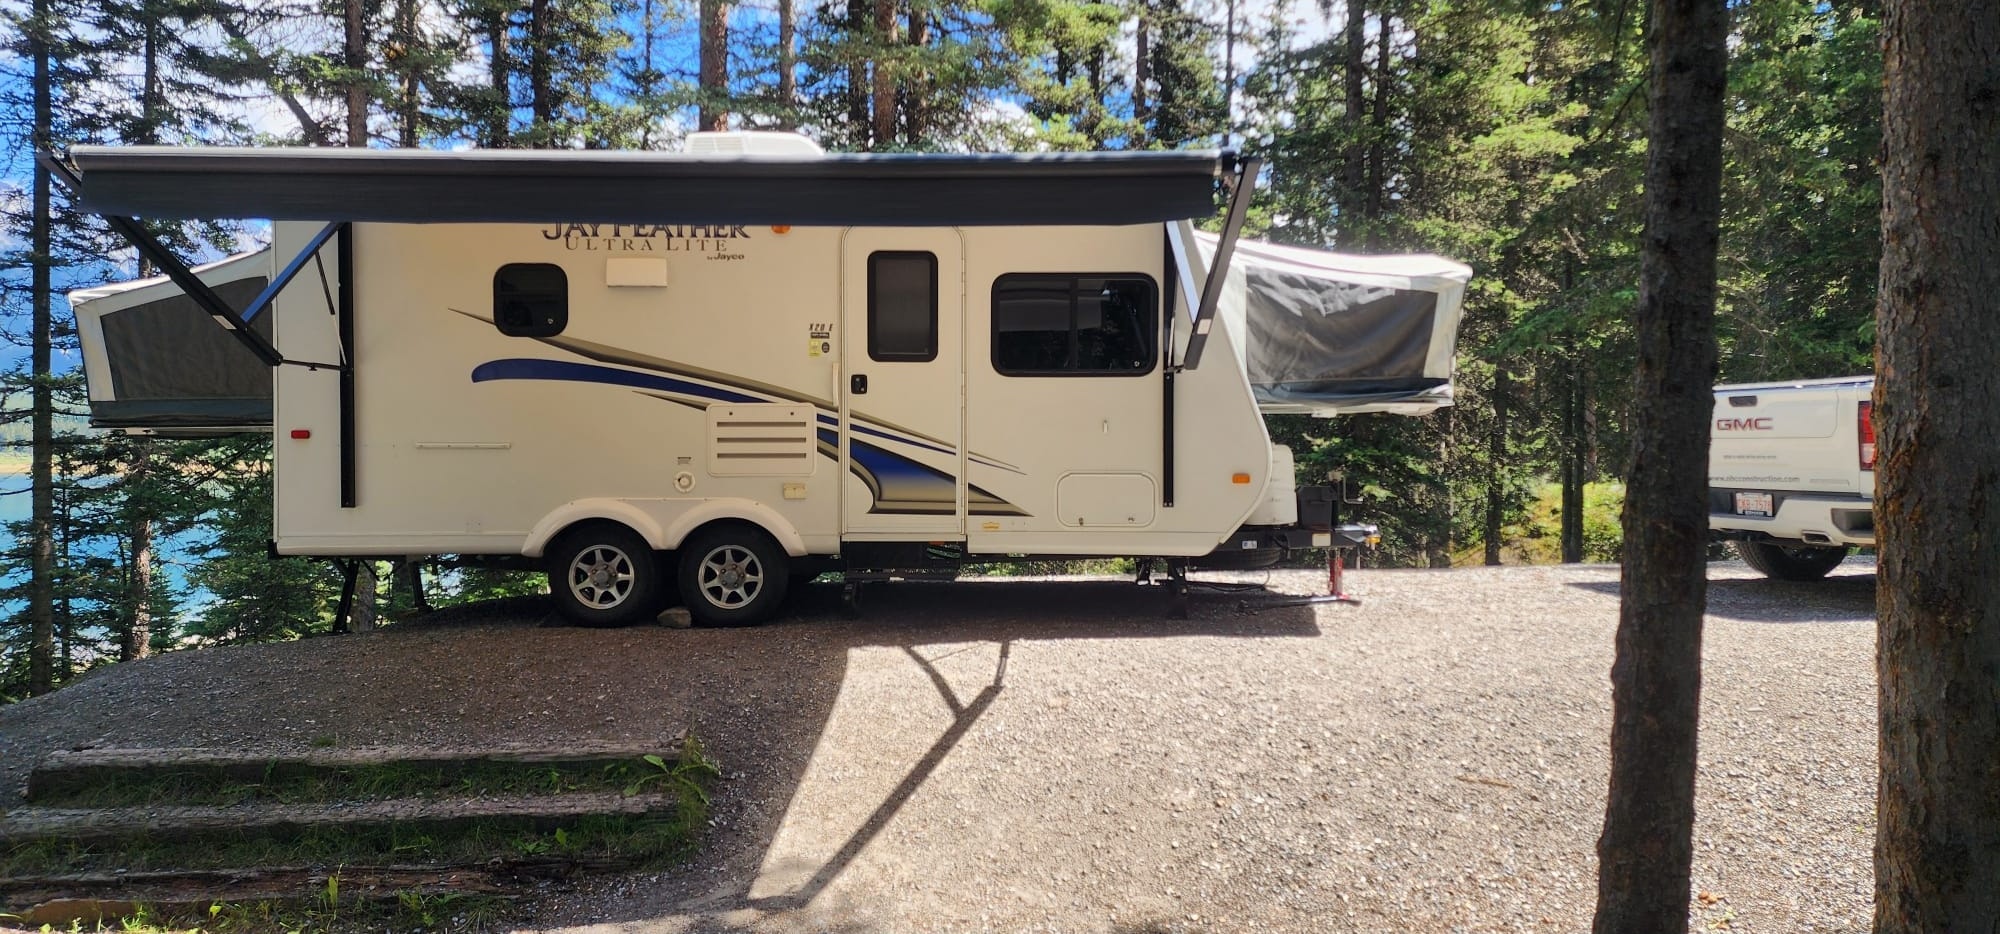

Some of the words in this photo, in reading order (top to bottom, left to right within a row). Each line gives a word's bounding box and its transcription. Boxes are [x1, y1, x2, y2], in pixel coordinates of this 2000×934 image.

[565, 237, 654, 251] ULTRA
[666, 237, 727, 251] LITE
[714, 252, 745, 261] Jayco
[1716, 417, 1774, 431] GMC
